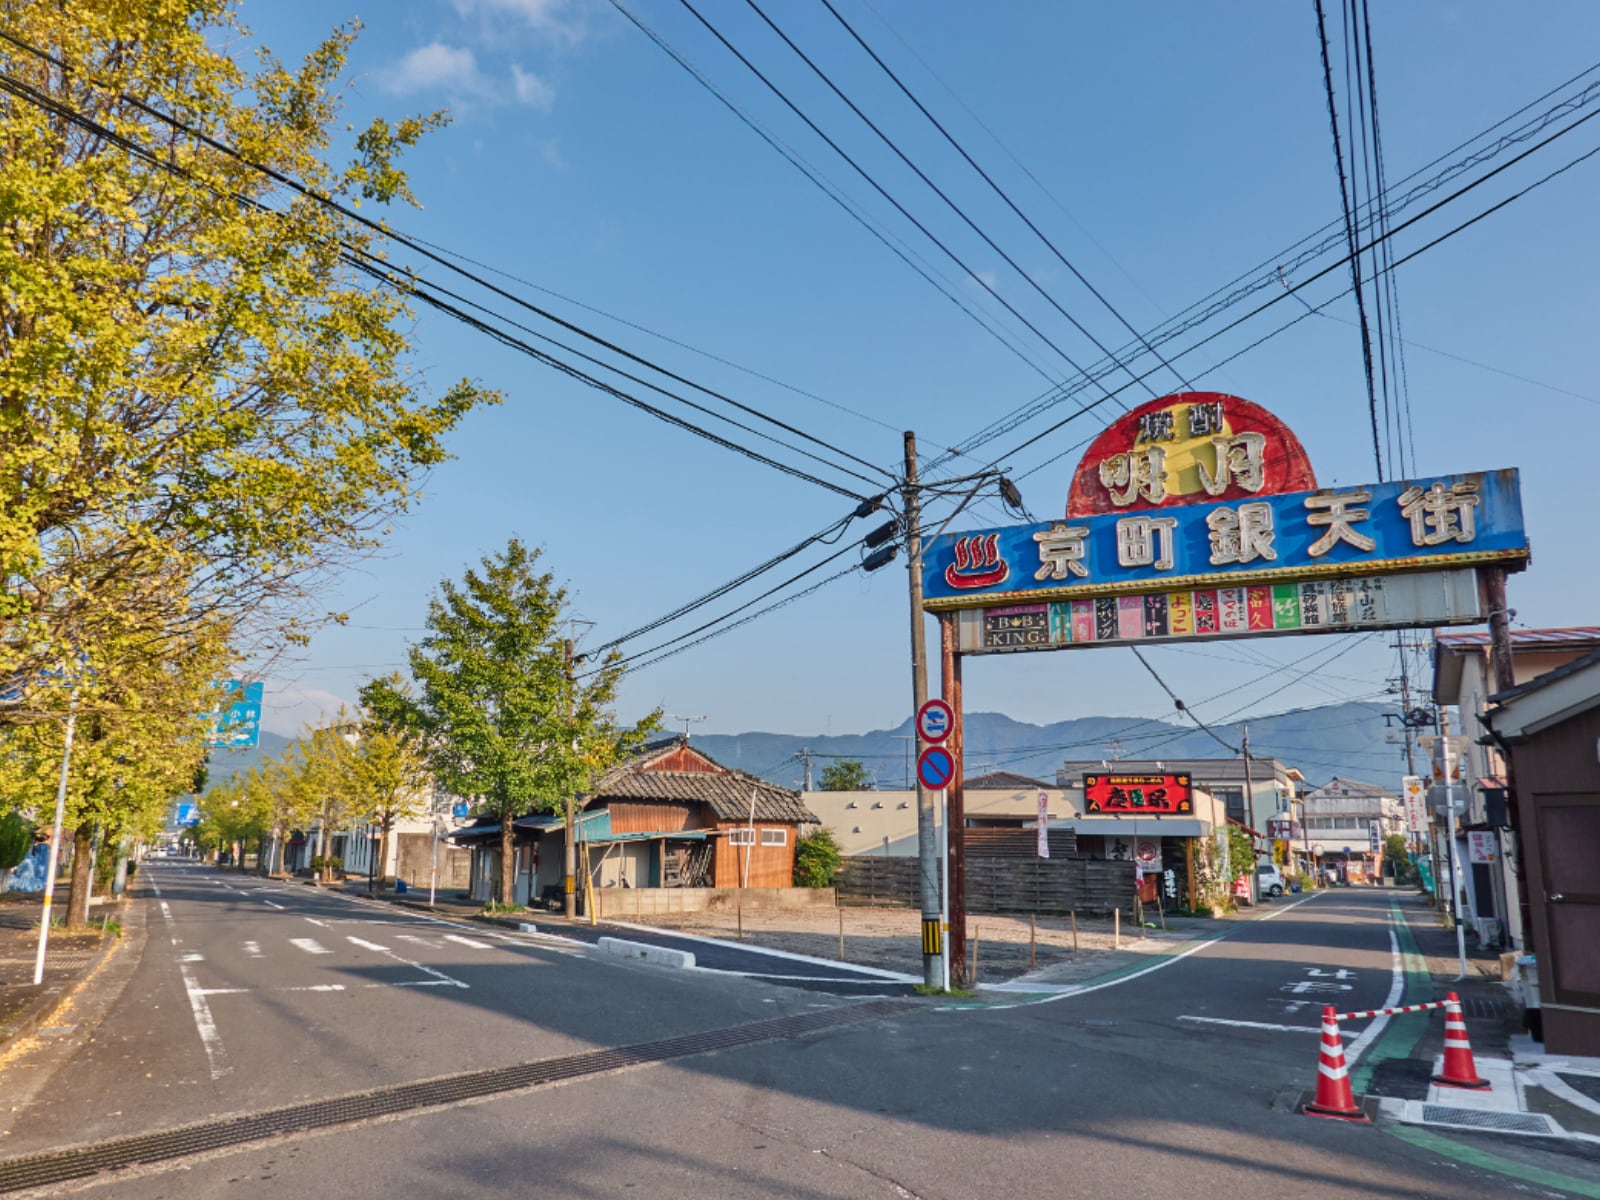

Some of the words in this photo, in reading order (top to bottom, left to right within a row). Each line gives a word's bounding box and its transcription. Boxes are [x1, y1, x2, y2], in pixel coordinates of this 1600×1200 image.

[1099, 432, 1266, 507] 明月
[1033, 482, 1480, 581] 京町銀天街
[992, 631, 1040, 646] KING
